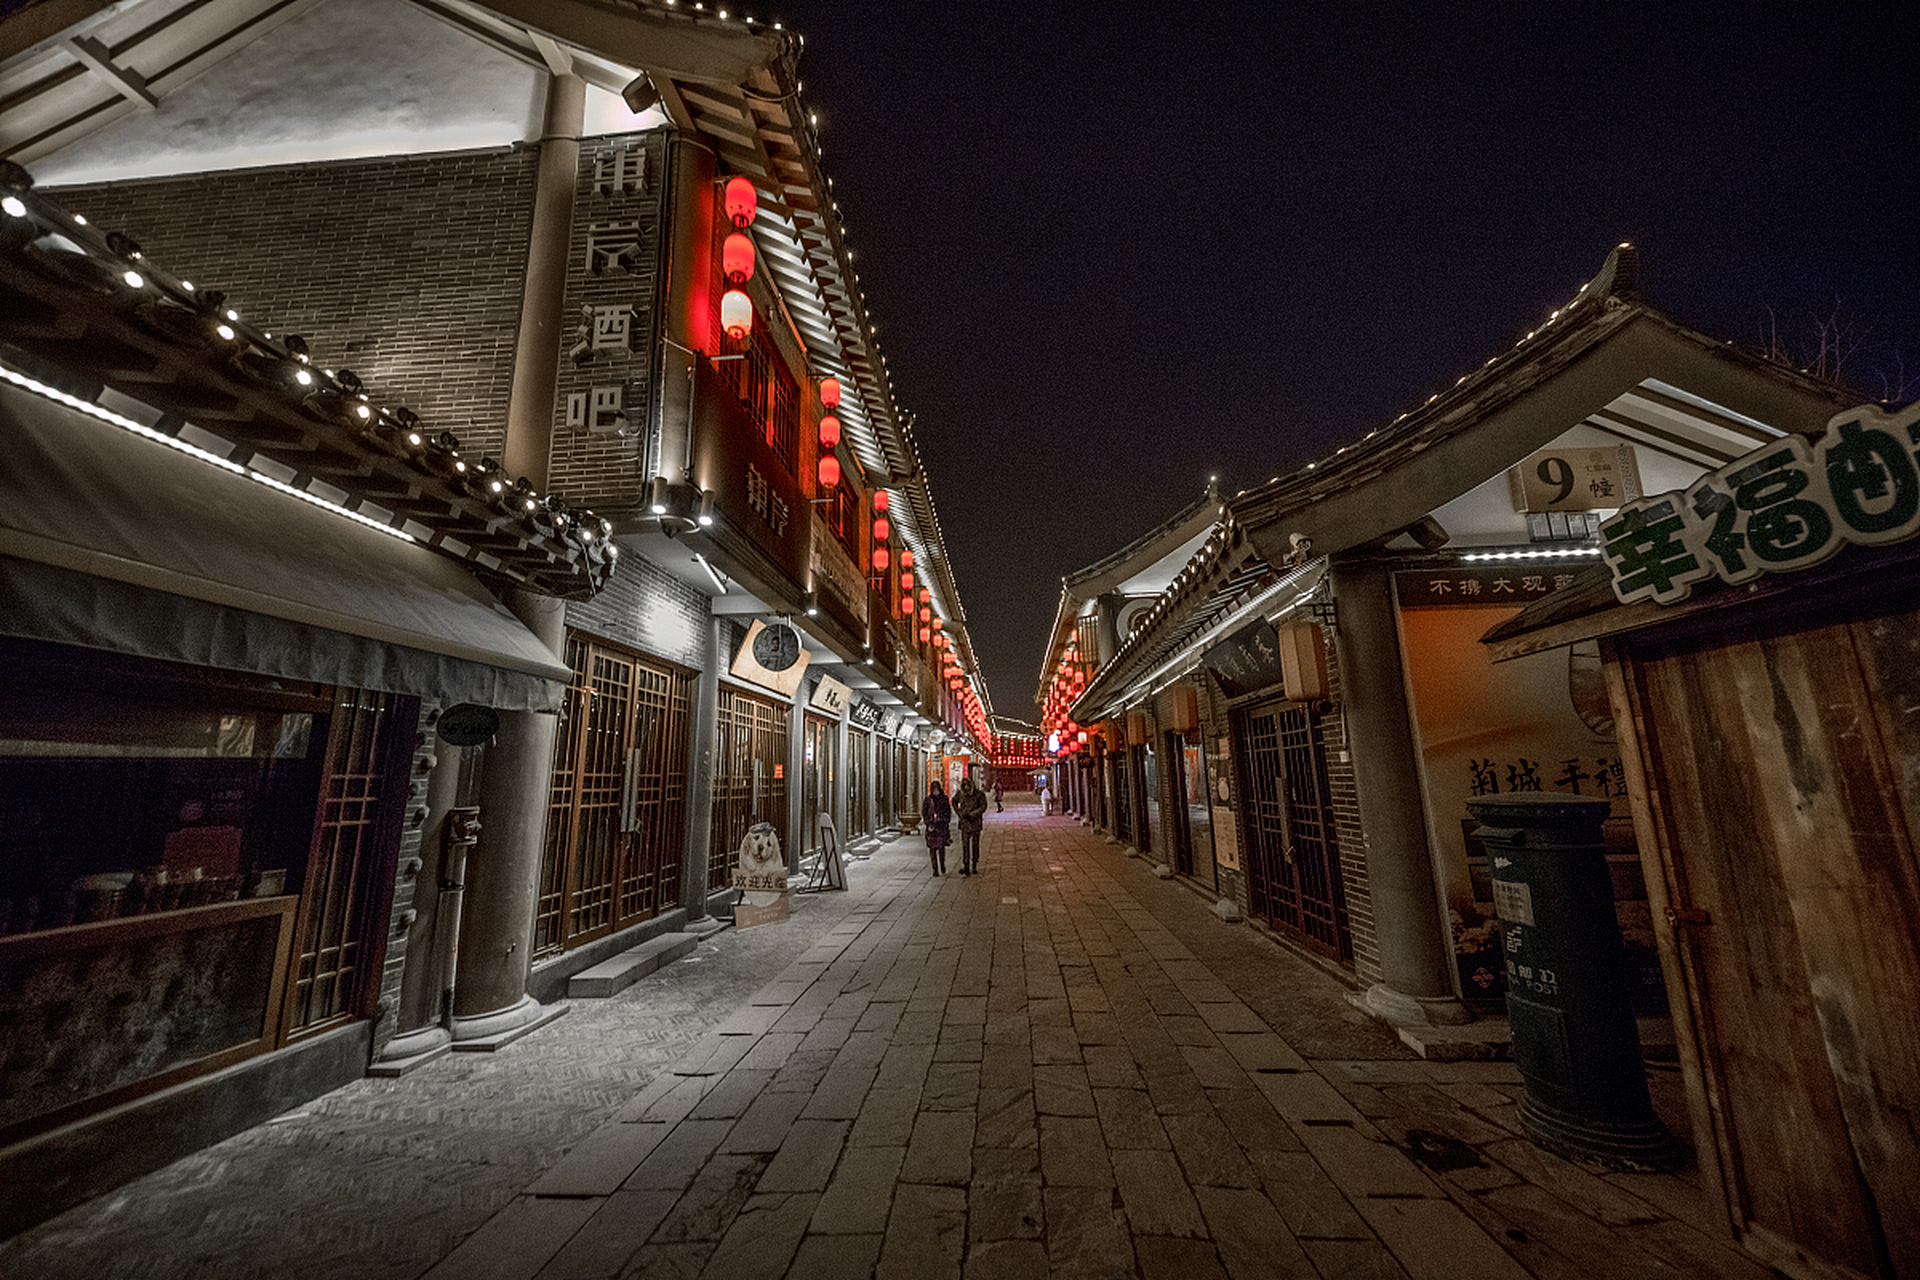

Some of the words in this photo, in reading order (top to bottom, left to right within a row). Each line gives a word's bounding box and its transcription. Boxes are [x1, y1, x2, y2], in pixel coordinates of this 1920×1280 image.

[1537, 457, 1574, 505] 9
[1602, 418, 1920, 597] 幸福的
[735, 874, 786, 889] 欢迎光临
[1525, 980, 1558, 995] POST
